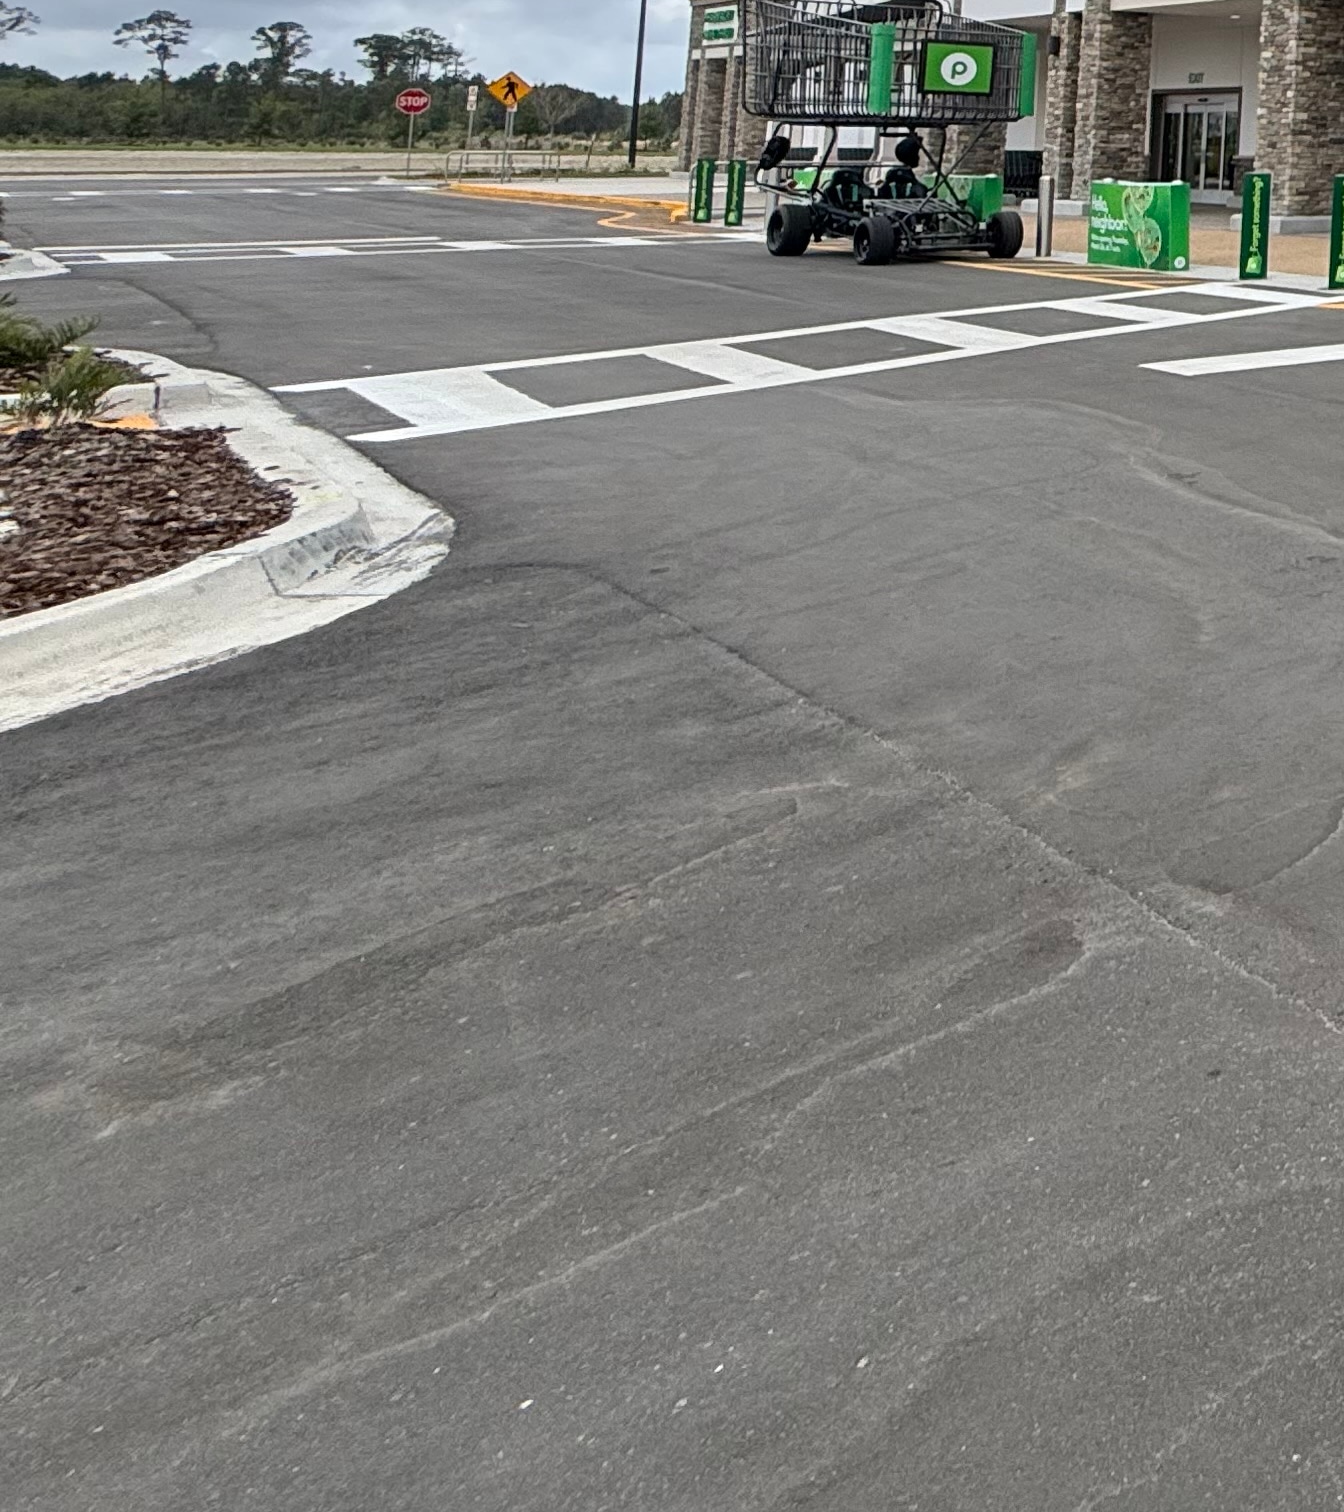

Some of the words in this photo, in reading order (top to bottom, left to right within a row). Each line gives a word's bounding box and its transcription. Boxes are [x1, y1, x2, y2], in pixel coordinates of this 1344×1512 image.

[1188, 72, 1205, 84] EXIT
[399, 95, 428, 107] STOP
[1249, 224, 1261, 252] Forget
